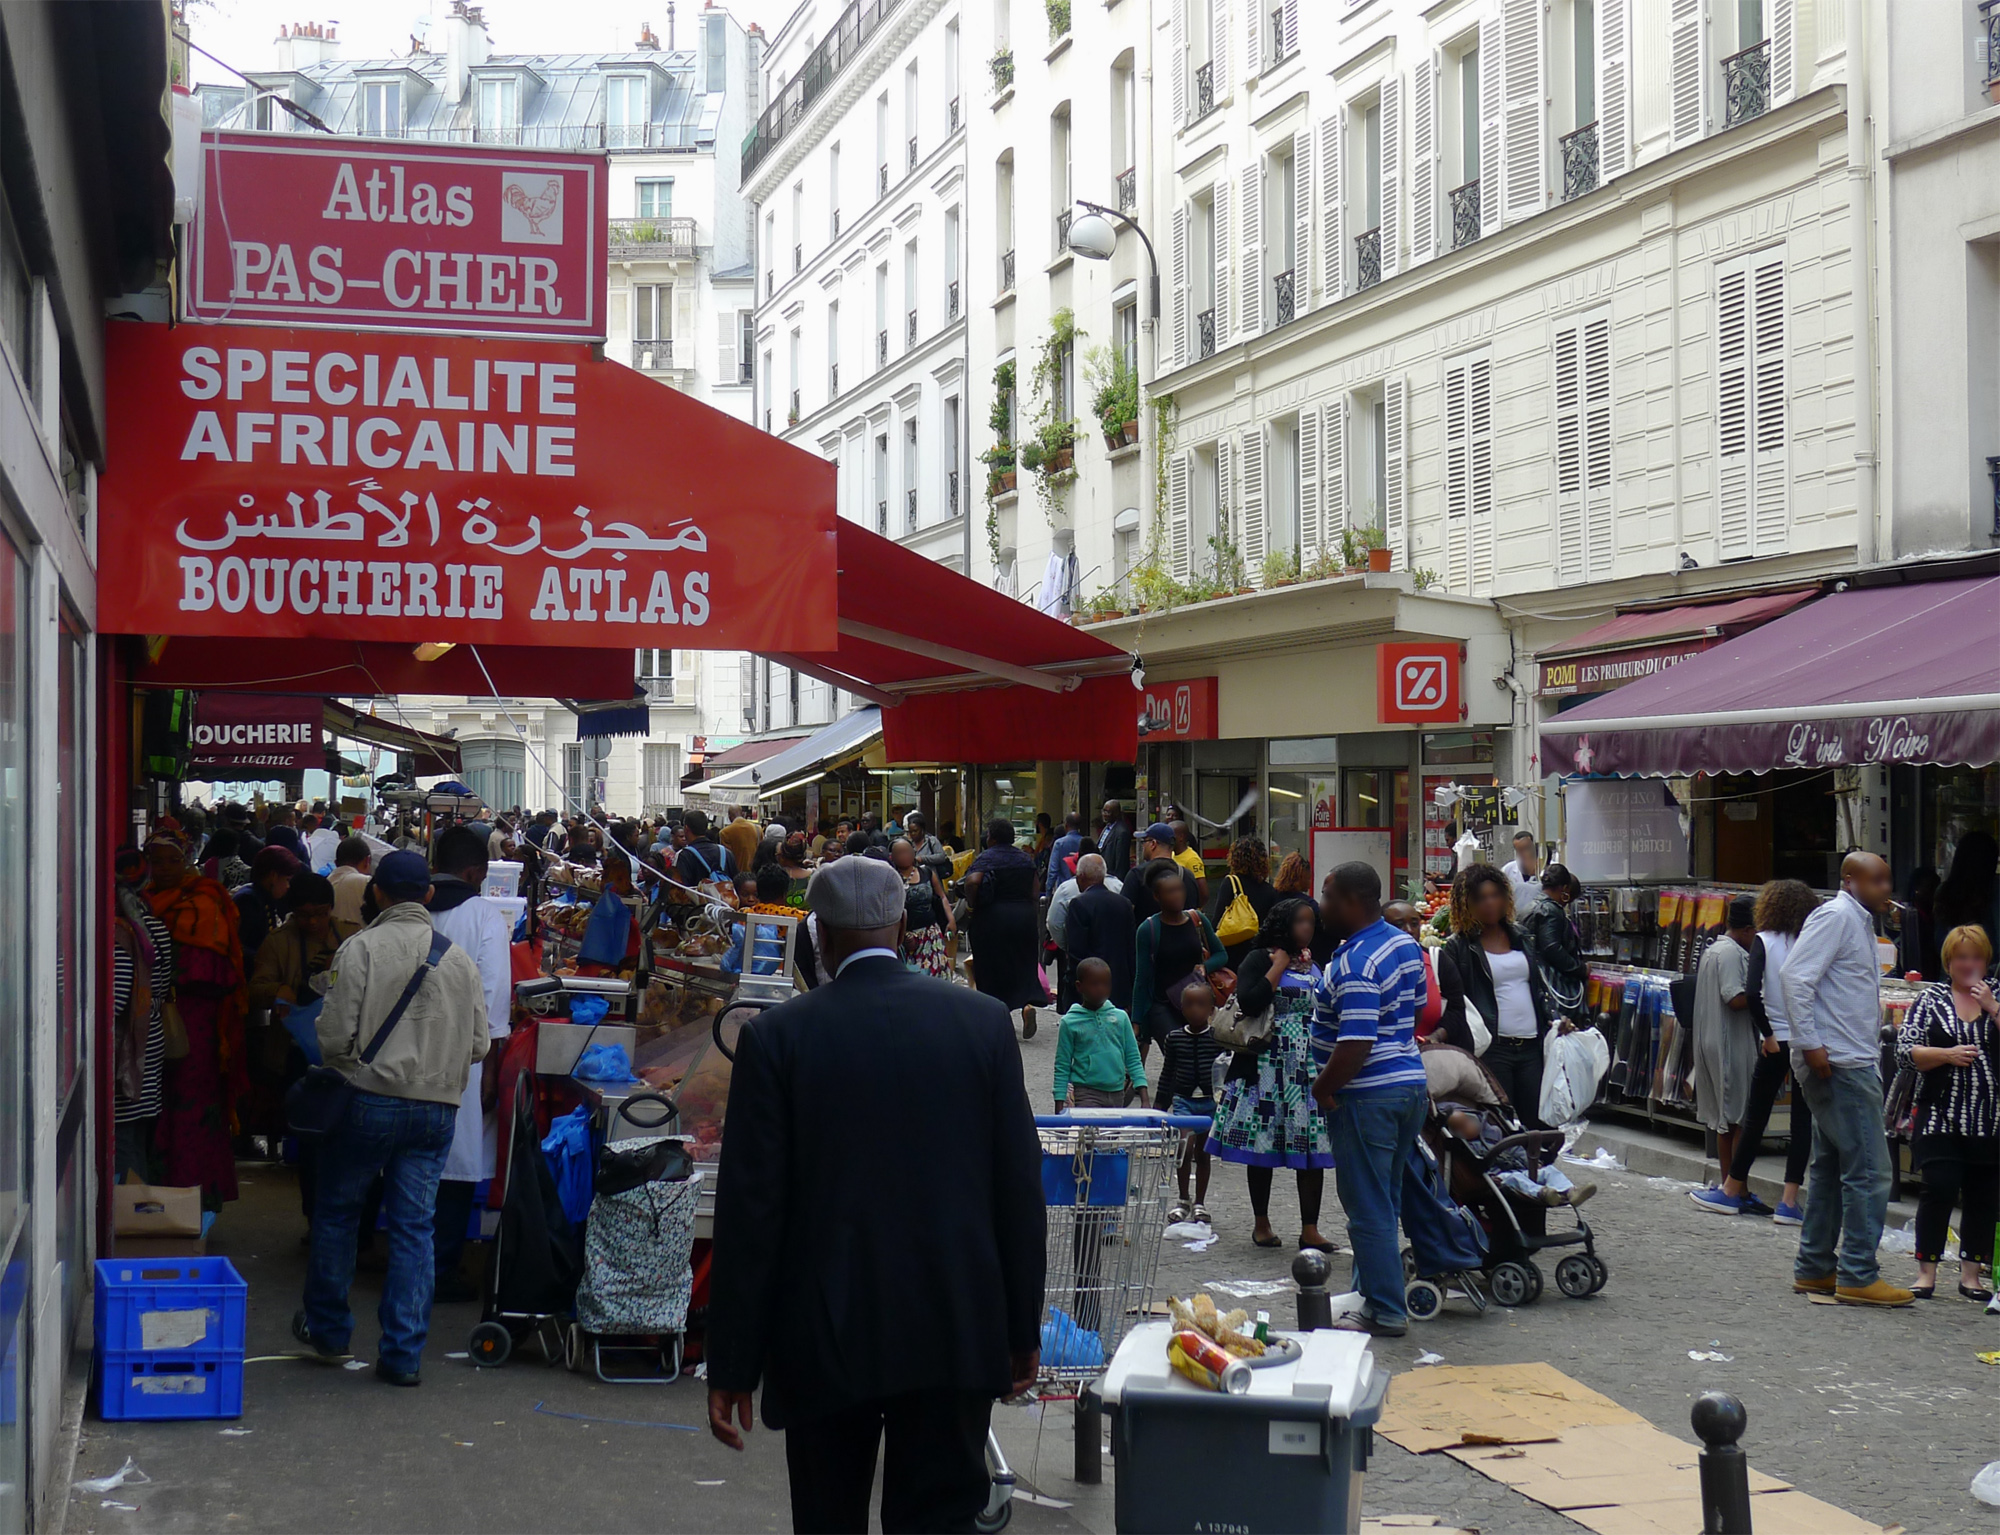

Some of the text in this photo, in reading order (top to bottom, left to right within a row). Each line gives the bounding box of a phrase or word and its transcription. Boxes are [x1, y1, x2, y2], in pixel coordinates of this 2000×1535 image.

[322, 163, 474, 227] Atlas
[180, 346, 577, 416] SPECIALITE
[180, 411, 577, 477] AFRICAINE
[178, 555, 711, 627] BOUCHERIE ATLAS
[1546, 664, 1577, 686] POMI
[1581, 666, 1599, 683] LES
[1600, 661, 1645, 681] PRIMEURS
[195, 723, 312, 745] OUCHERIE
[1864, 717, 1929, 762] Noire
